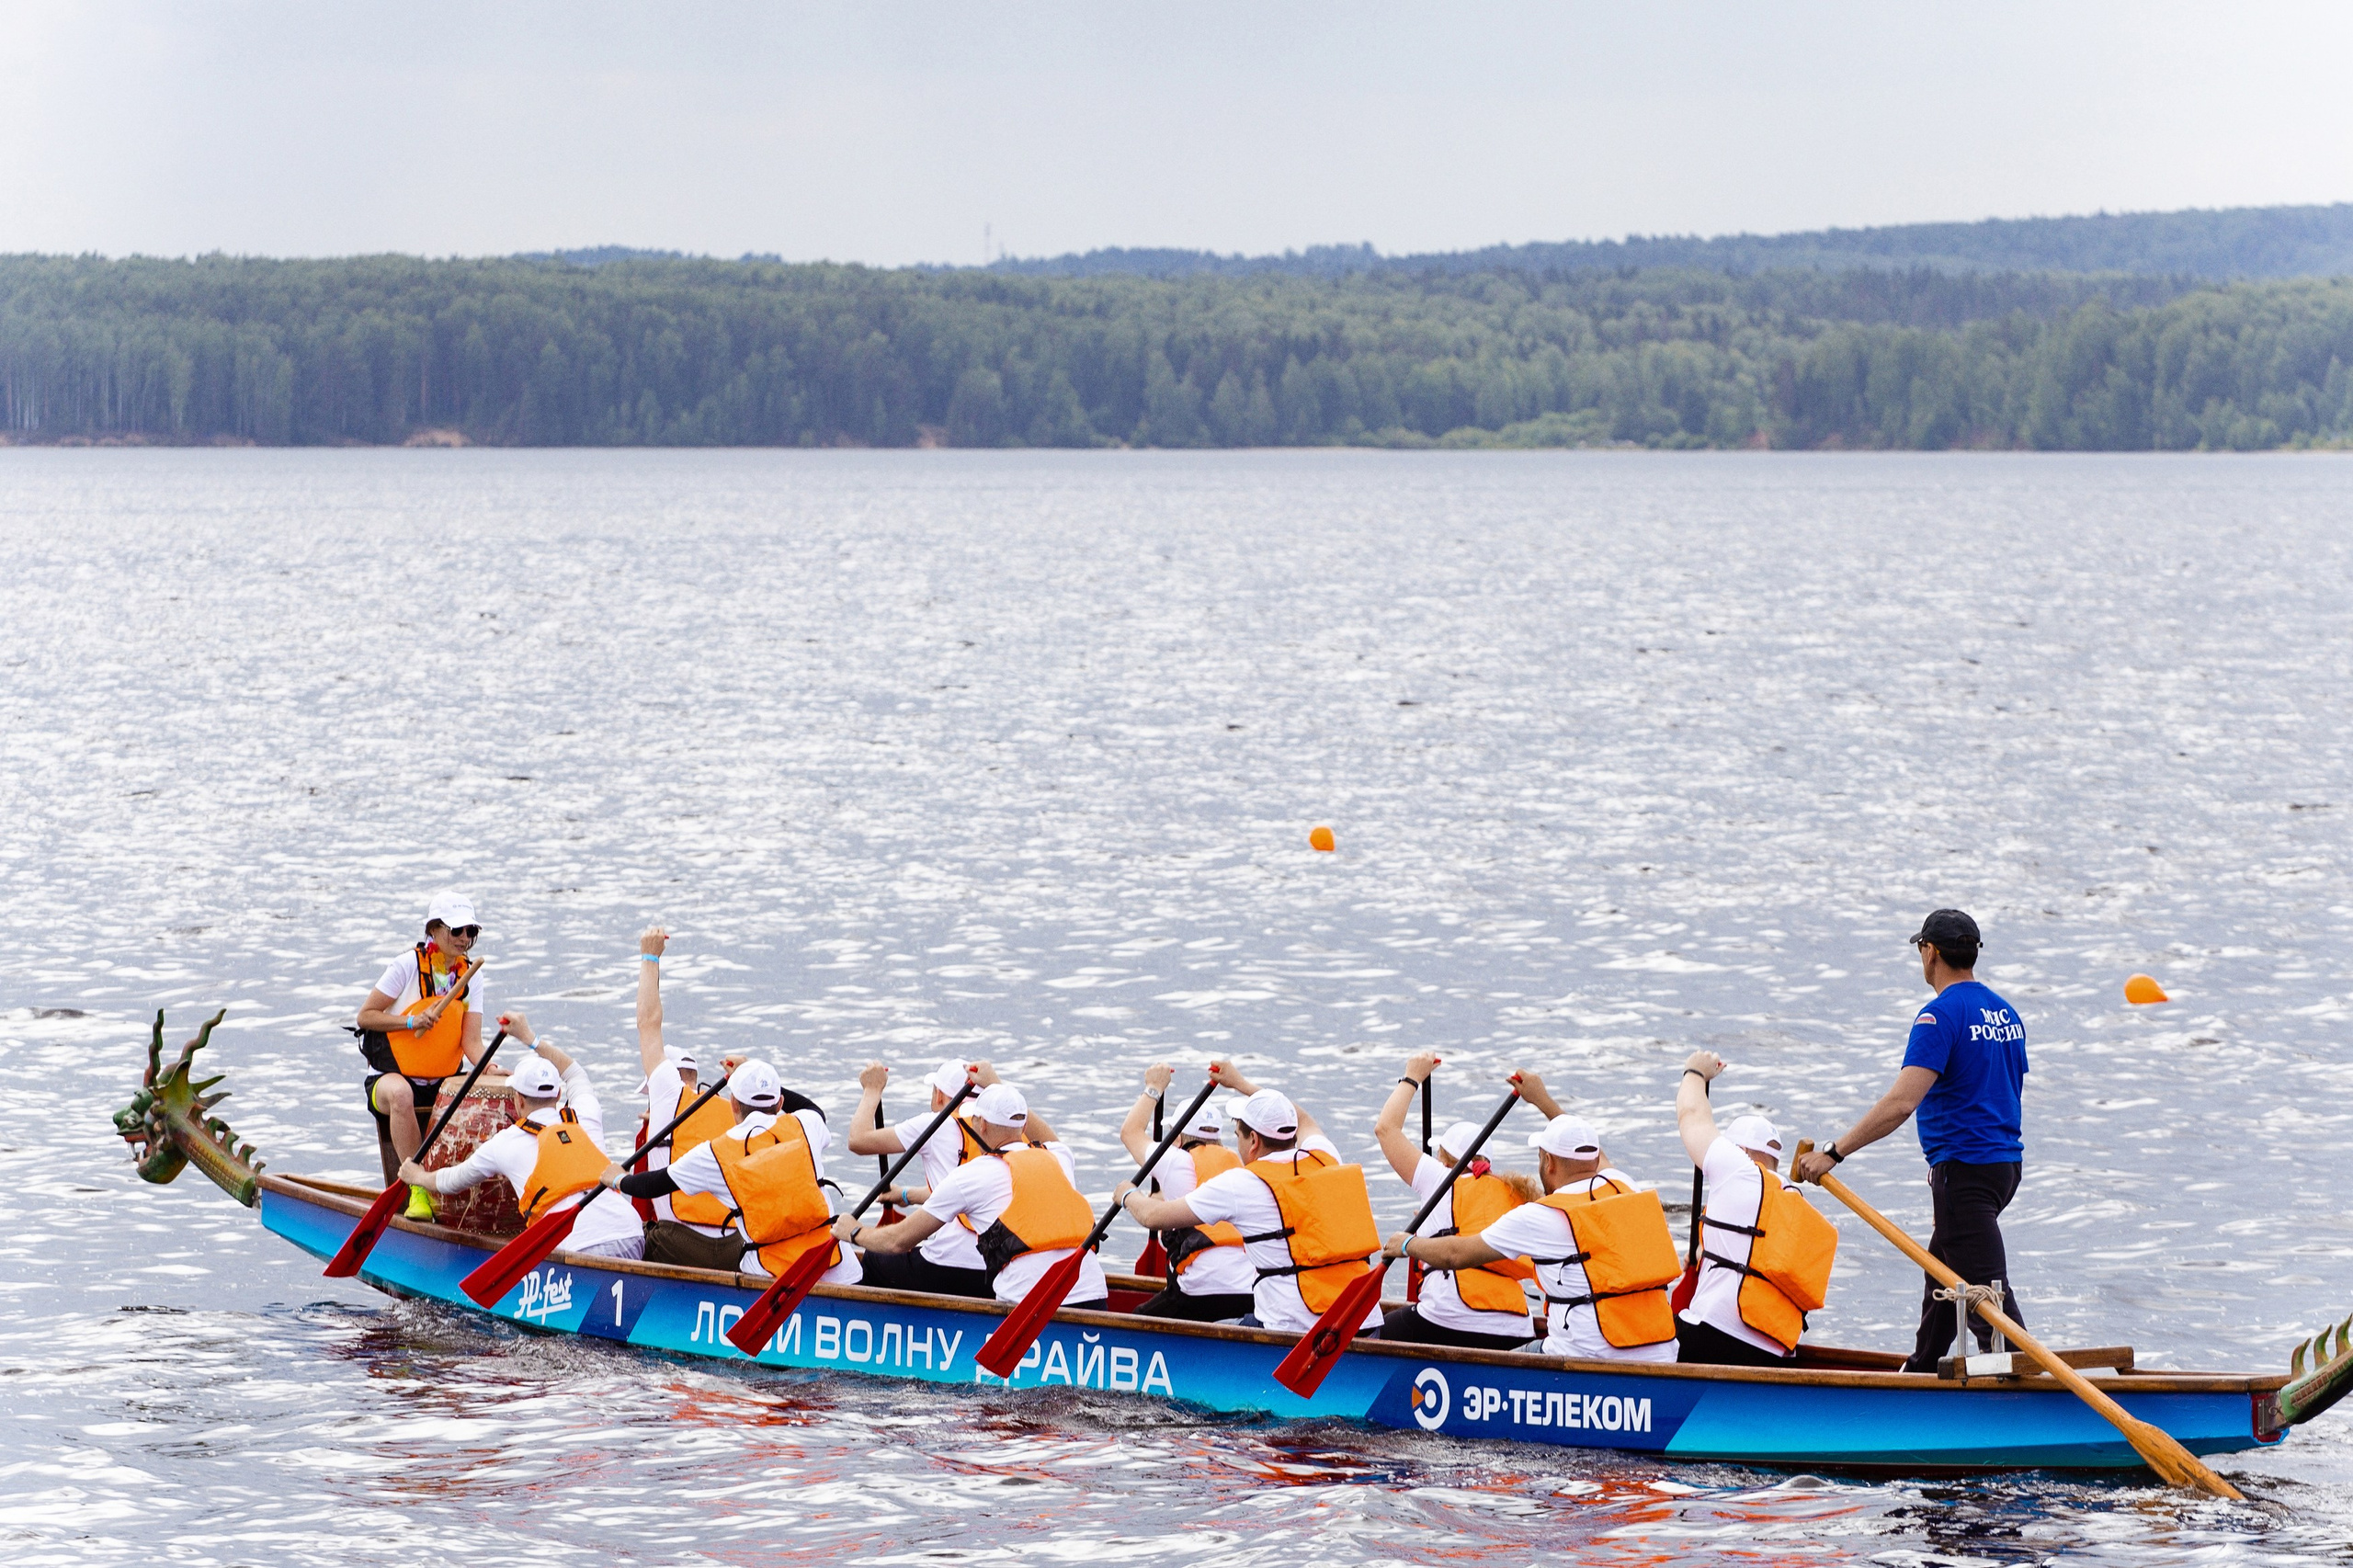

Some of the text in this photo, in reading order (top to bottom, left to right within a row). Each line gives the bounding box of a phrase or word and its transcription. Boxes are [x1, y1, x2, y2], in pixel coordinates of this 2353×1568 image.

[610, 1278, 624, 1327] 1
[690, 1301, 802, 1357] ЛОИ
[814, 1315, 963, 1371] ВОЛНУ
